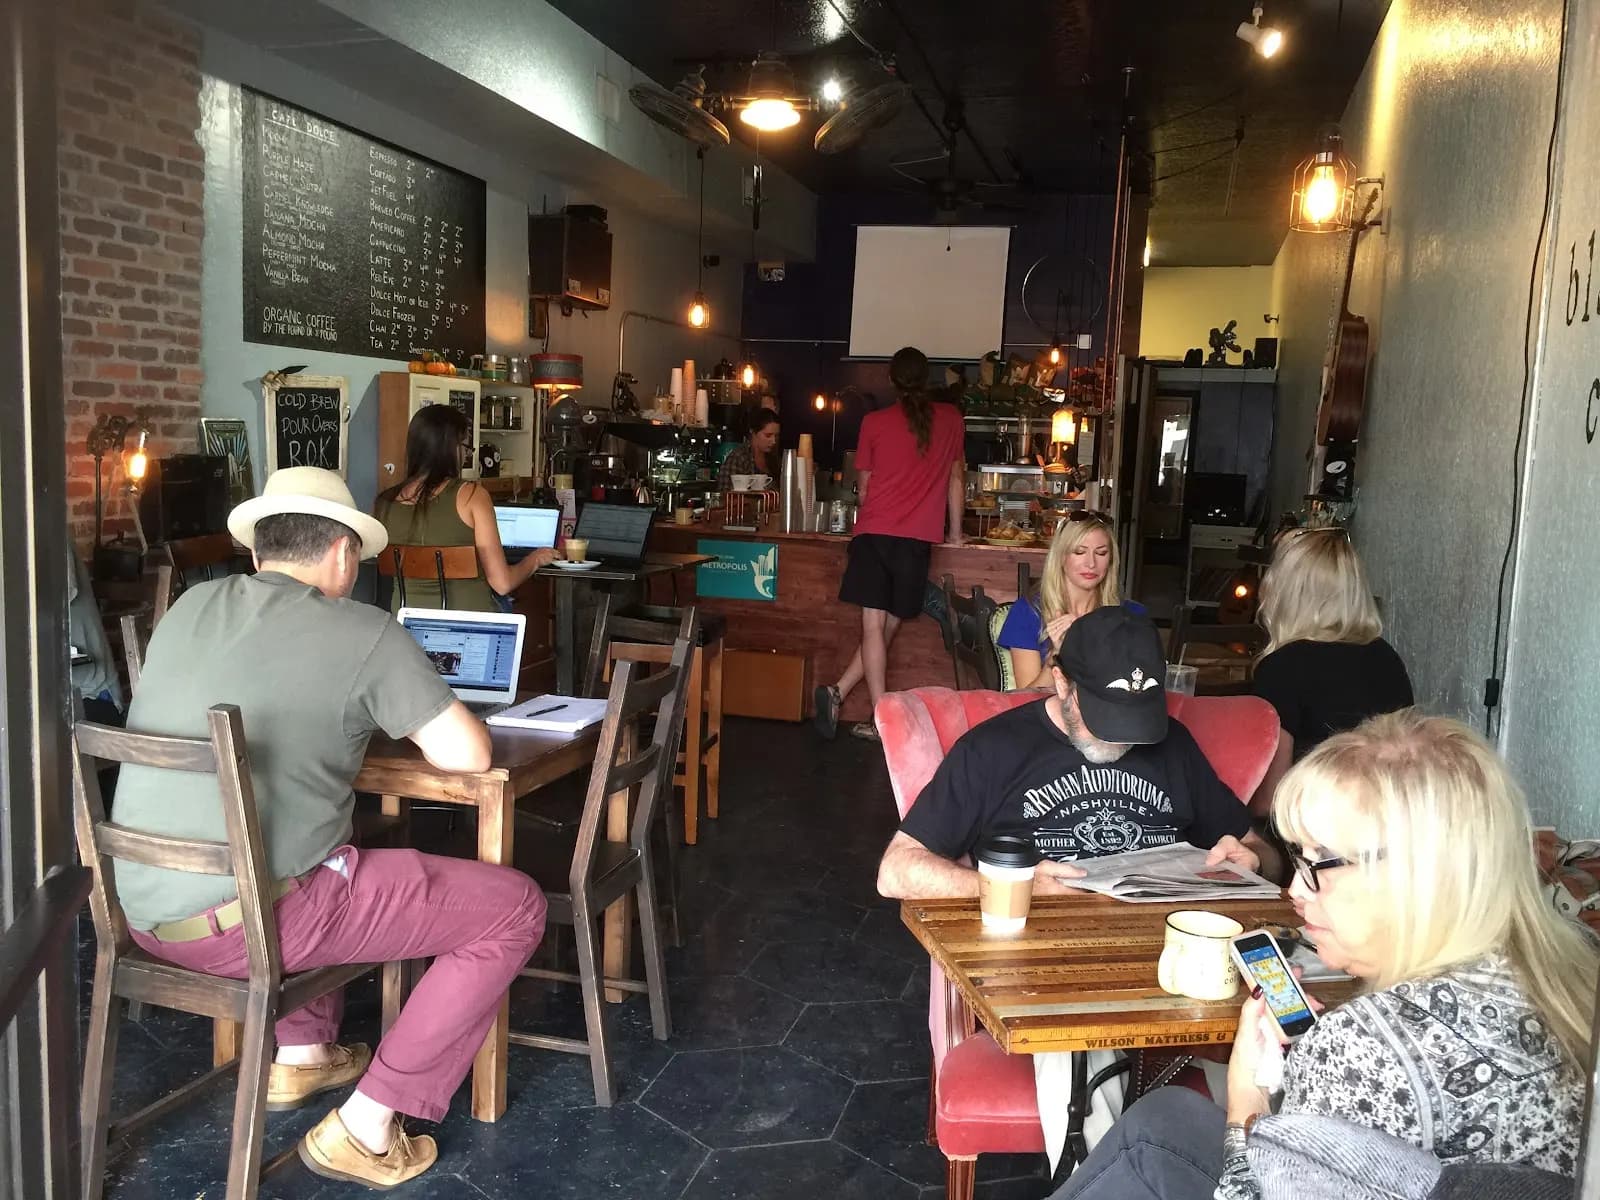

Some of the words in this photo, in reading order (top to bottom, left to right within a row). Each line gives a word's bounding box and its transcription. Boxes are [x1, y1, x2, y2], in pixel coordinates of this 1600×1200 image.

[299, 213, 326, 232] MOCHA
[299, 232, 325, 250] MOCHA
[310, 254, 337, 273] MOCHA
[370, 250, 392, 268] LATTE
[291, 268, 309, 284] BEAN
[1566, 229, 1600, 326] bl
[370, 285, 392, 300] DOLCE
[394, 291, 407, 304] HOT
[370, 302, 390, 318] DOLCE
[263, 321, 272, 334] BY
[275, 322, 286, 334] THE
[306, 314, 336, 332] COFFEE
[370, 320, 386, 334] CHAI
[370, 336, 384, 349] TEA
[278, 392, 306, 410] COLD
[310, 393, 340, 412] BREW
[282, 416, 312, 439] POUR
[702, 562, 748, 571] METROPOLIS
[1024, 772, 1082, 816] RYMAN
[1080, 764, 1165, 810] AUDITORIUM
[1060, 798, 1148, 818] NASHVILLE
[1034, 838, 1076, 848] MOTHER
[1142, 834, 1176, 845] CHURCH
[1085, 1036, 1136, 1048] WILSON
[1144, 1032, 1210, 1045] MATTRESS
